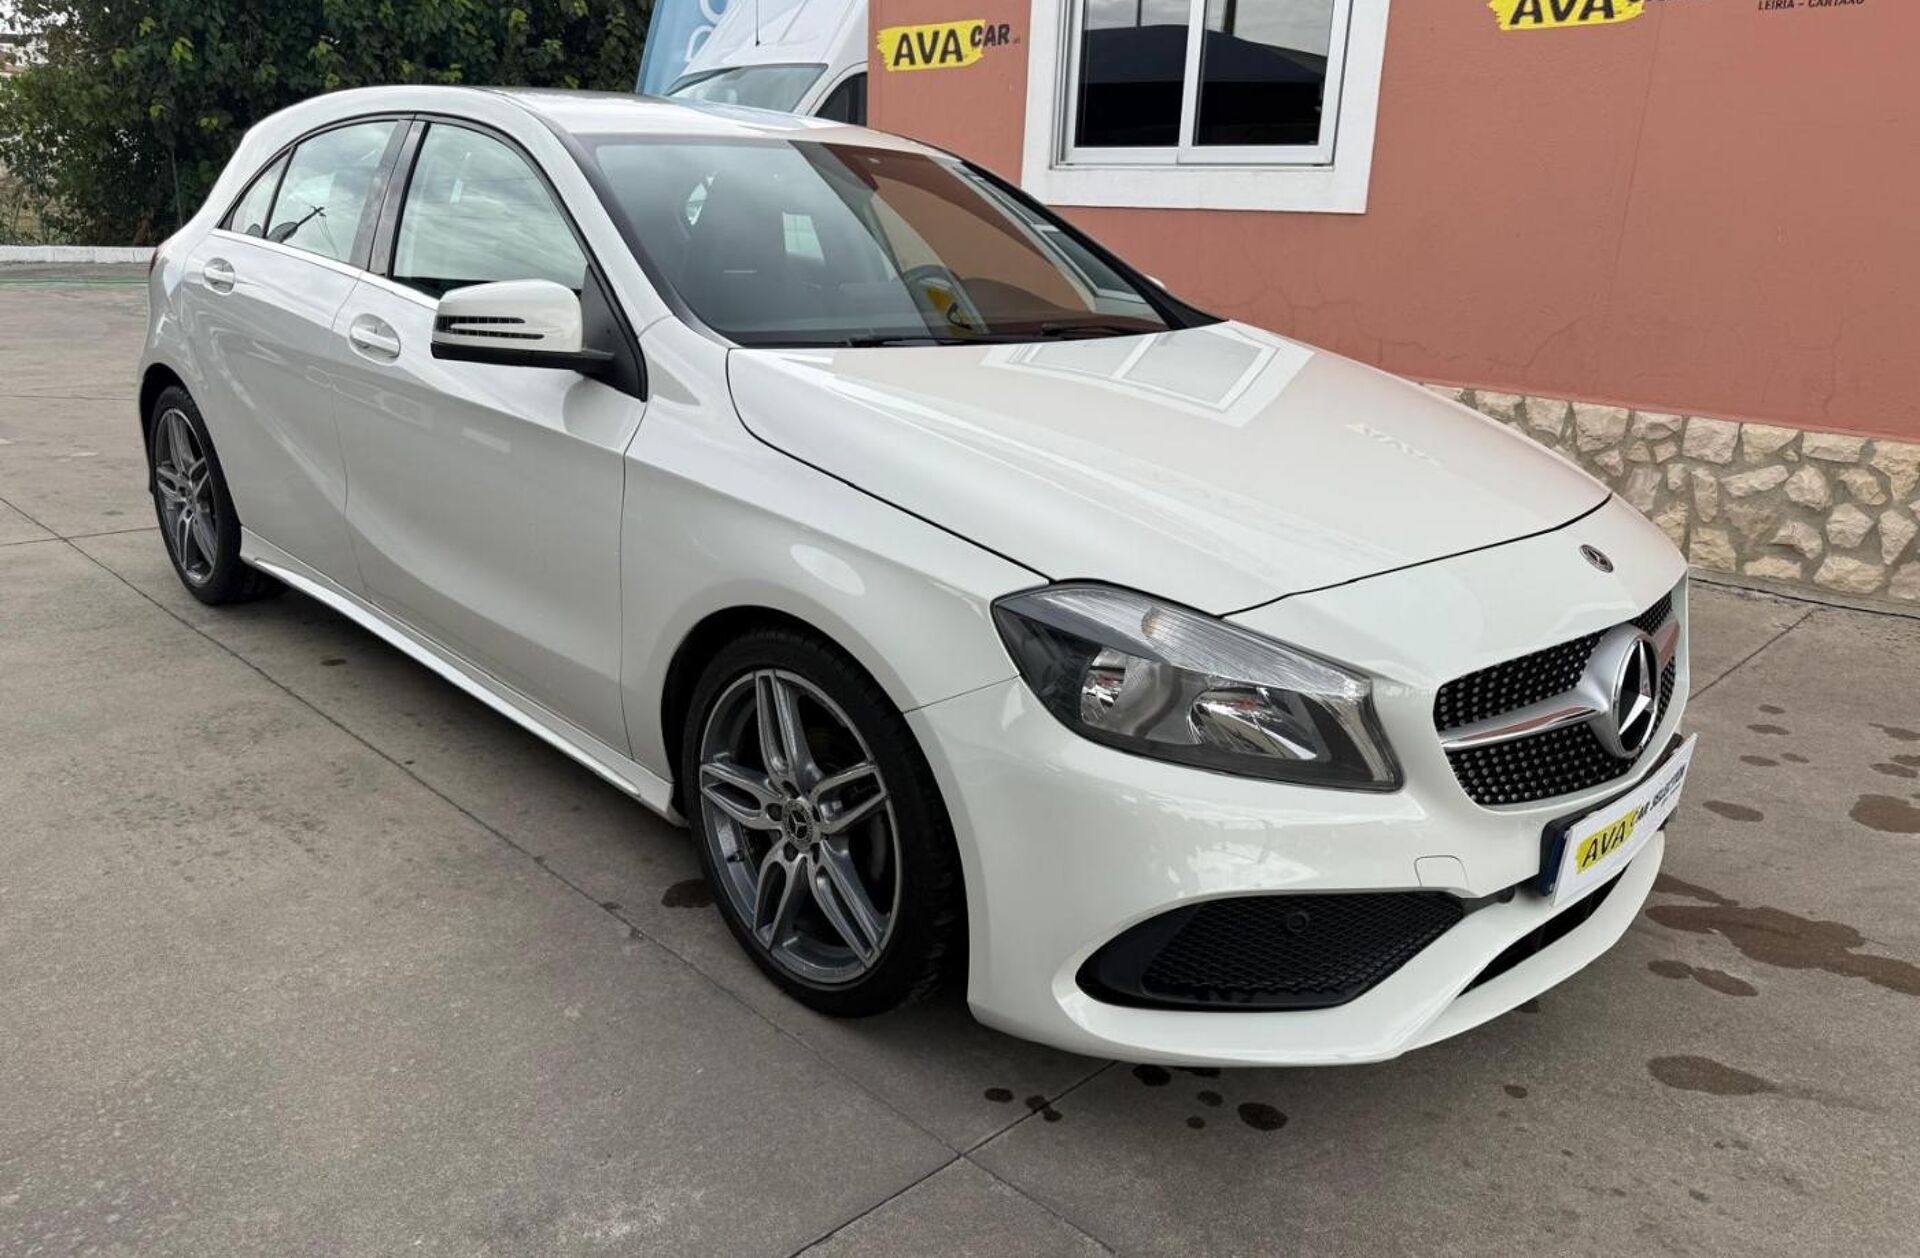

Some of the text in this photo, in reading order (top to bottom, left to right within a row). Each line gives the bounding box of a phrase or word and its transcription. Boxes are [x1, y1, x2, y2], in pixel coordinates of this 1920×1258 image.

[1758, 0, 1794, 10] LEIRIA
[893, 24, 1010, 66] AVA CAR
[1582, 821, 1626, 868] AVA
